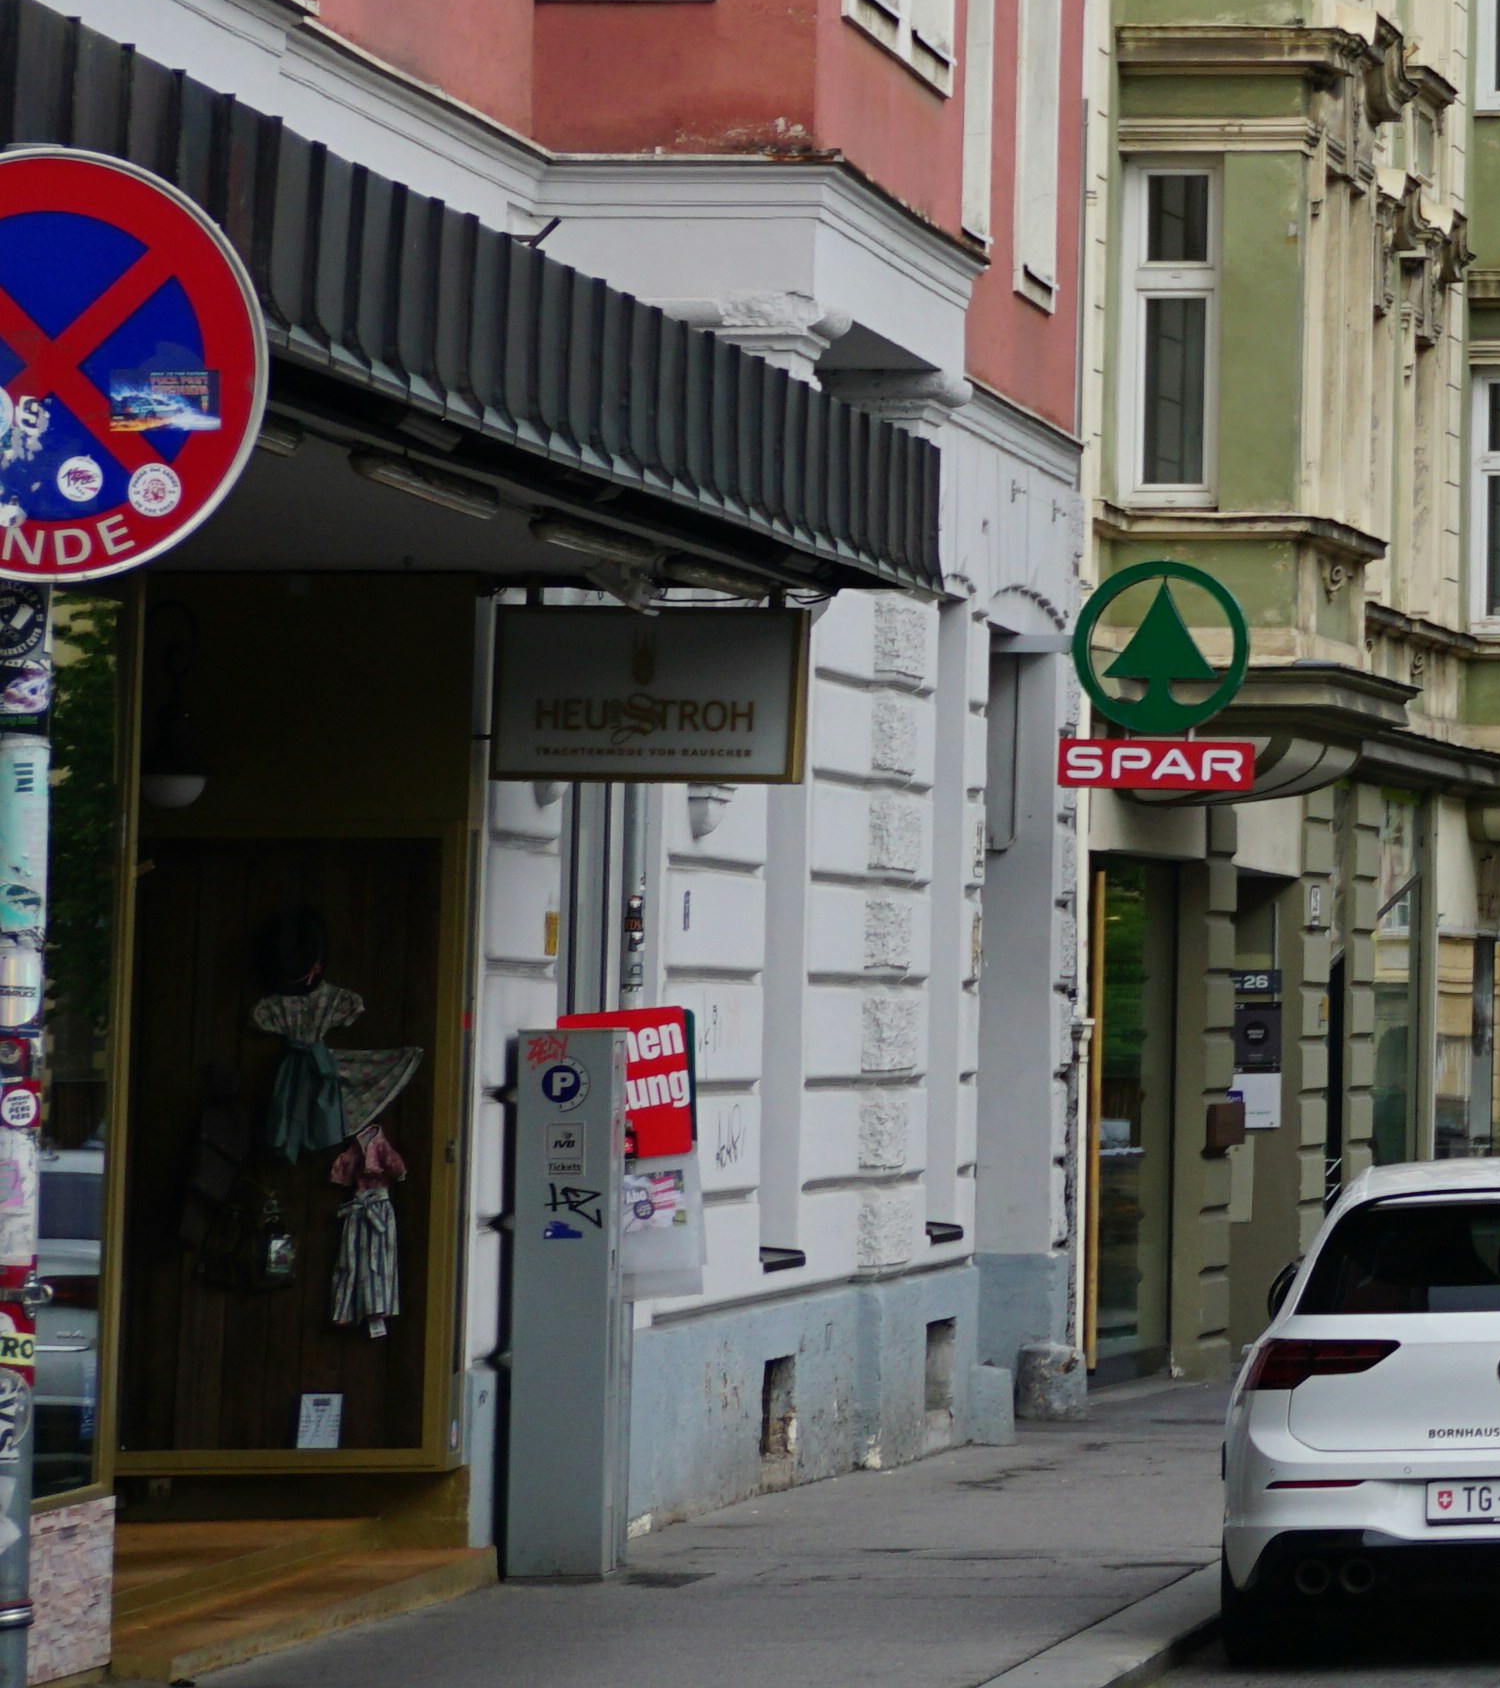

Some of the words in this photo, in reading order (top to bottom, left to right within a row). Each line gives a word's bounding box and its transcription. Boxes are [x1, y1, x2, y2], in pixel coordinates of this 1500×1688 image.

[535, 698, 608, 731] HEU
[651, 747, 676, 757] VON
[682, 748, 752, 758] RAUSCHER
[1066, 745, 1243, 782] SPAR
[1243, 974, 1269, 990] 26
[553, 1139, 576, 1149] IVB
[548, 1163, 582, 1172] Tickets
[626, 1188, 647, 1204] Abo
